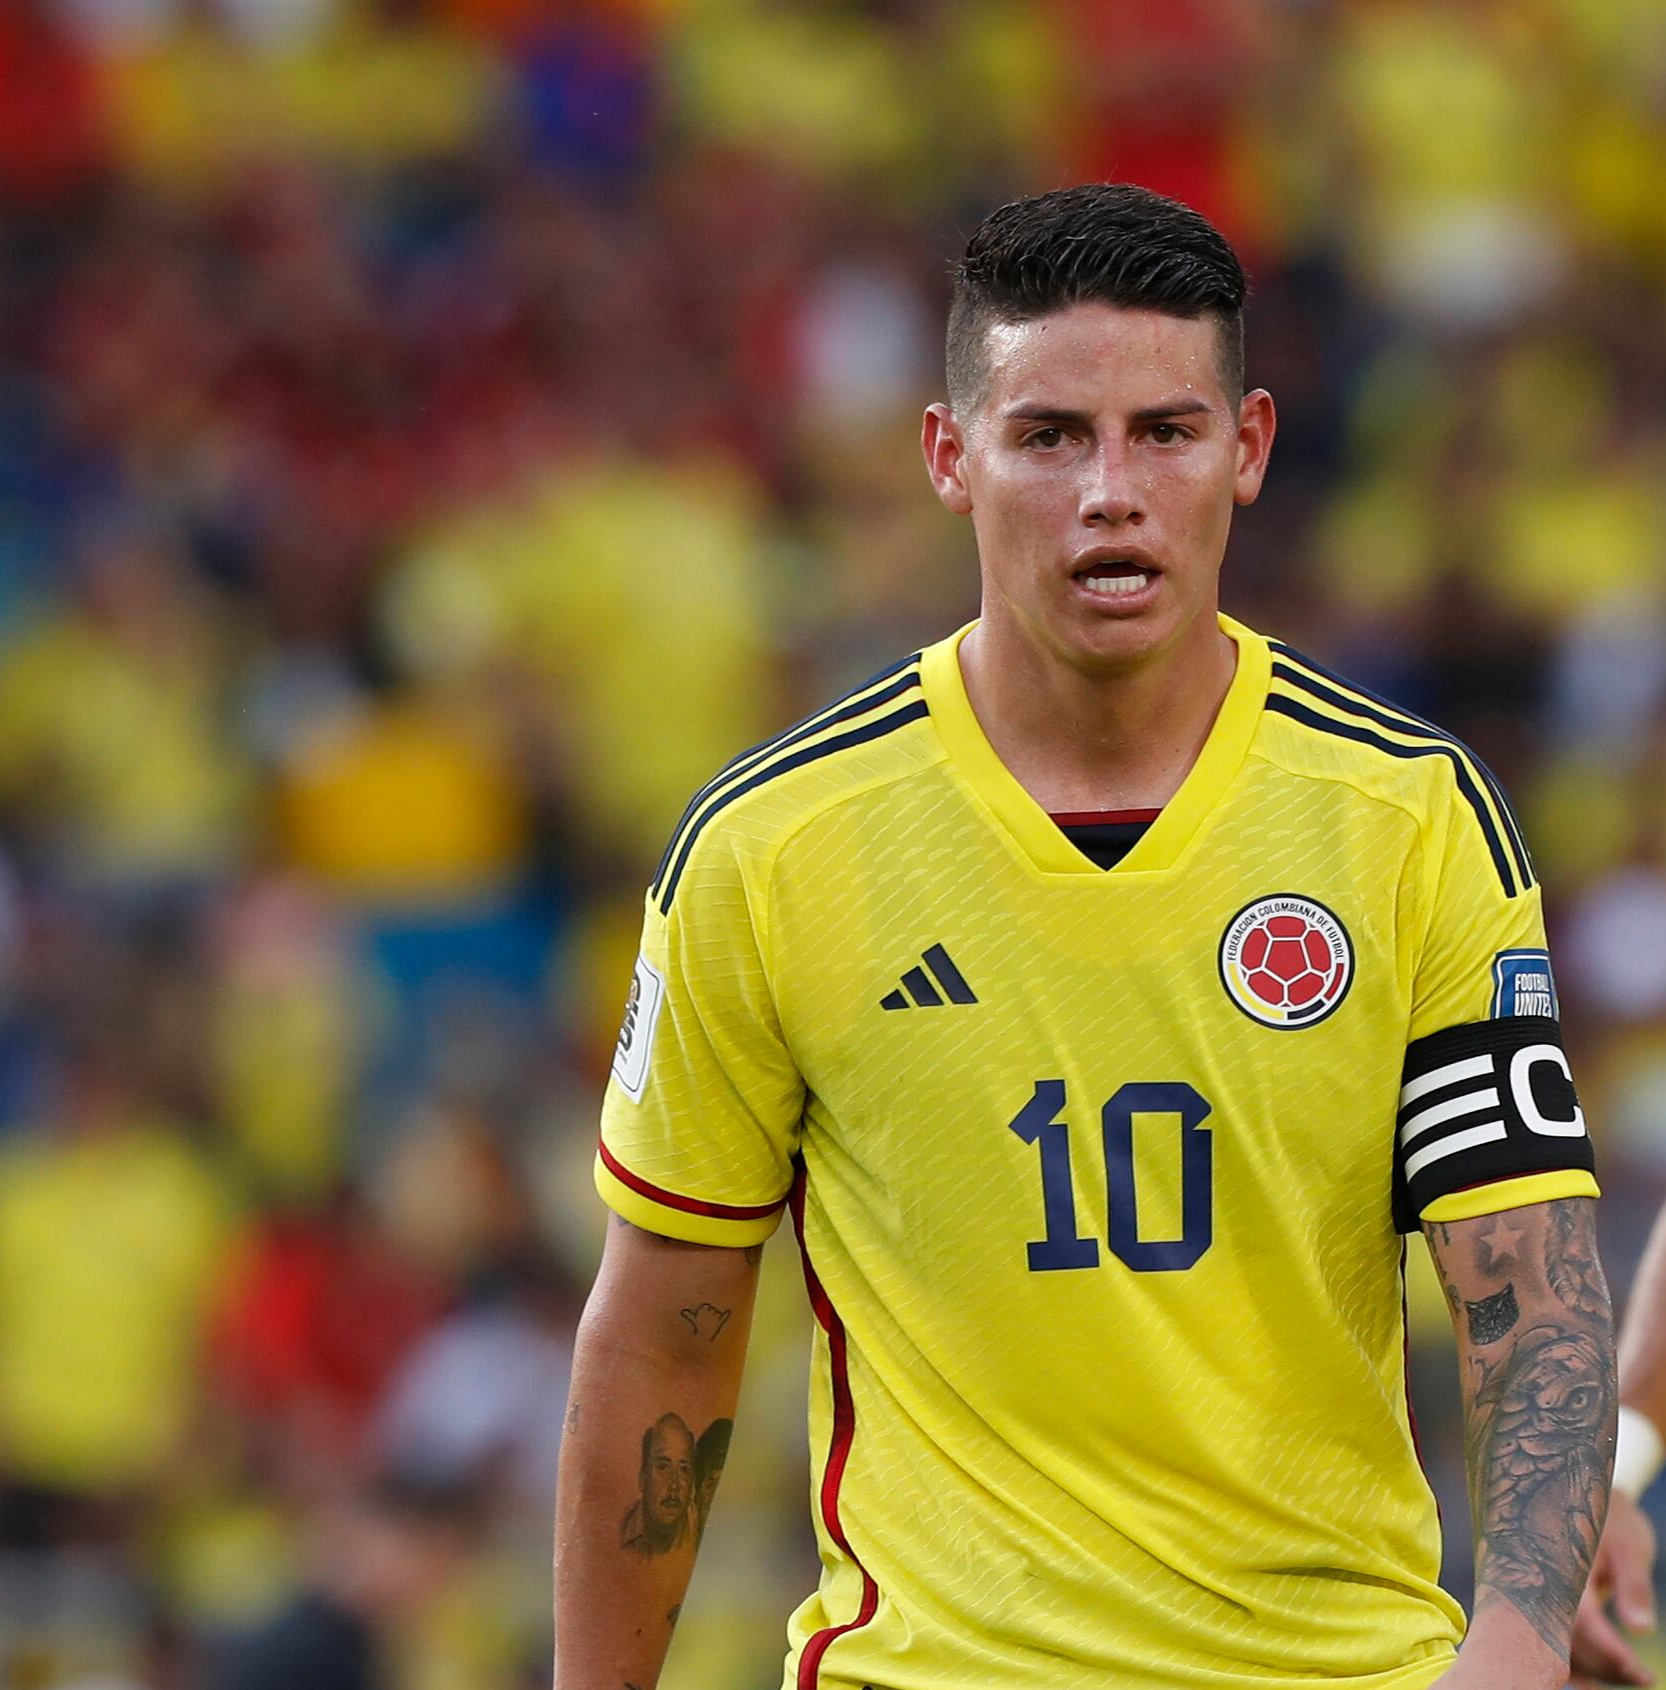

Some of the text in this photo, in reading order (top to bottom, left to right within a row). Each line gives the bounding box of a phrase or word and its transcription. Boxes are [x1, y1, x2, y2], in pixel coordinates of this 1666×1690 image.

[1227, 902, 1345, 961] FEDERACION COLOMBIANA DE FUTBOL
[1008, 1078, 1213, 1273] 10
